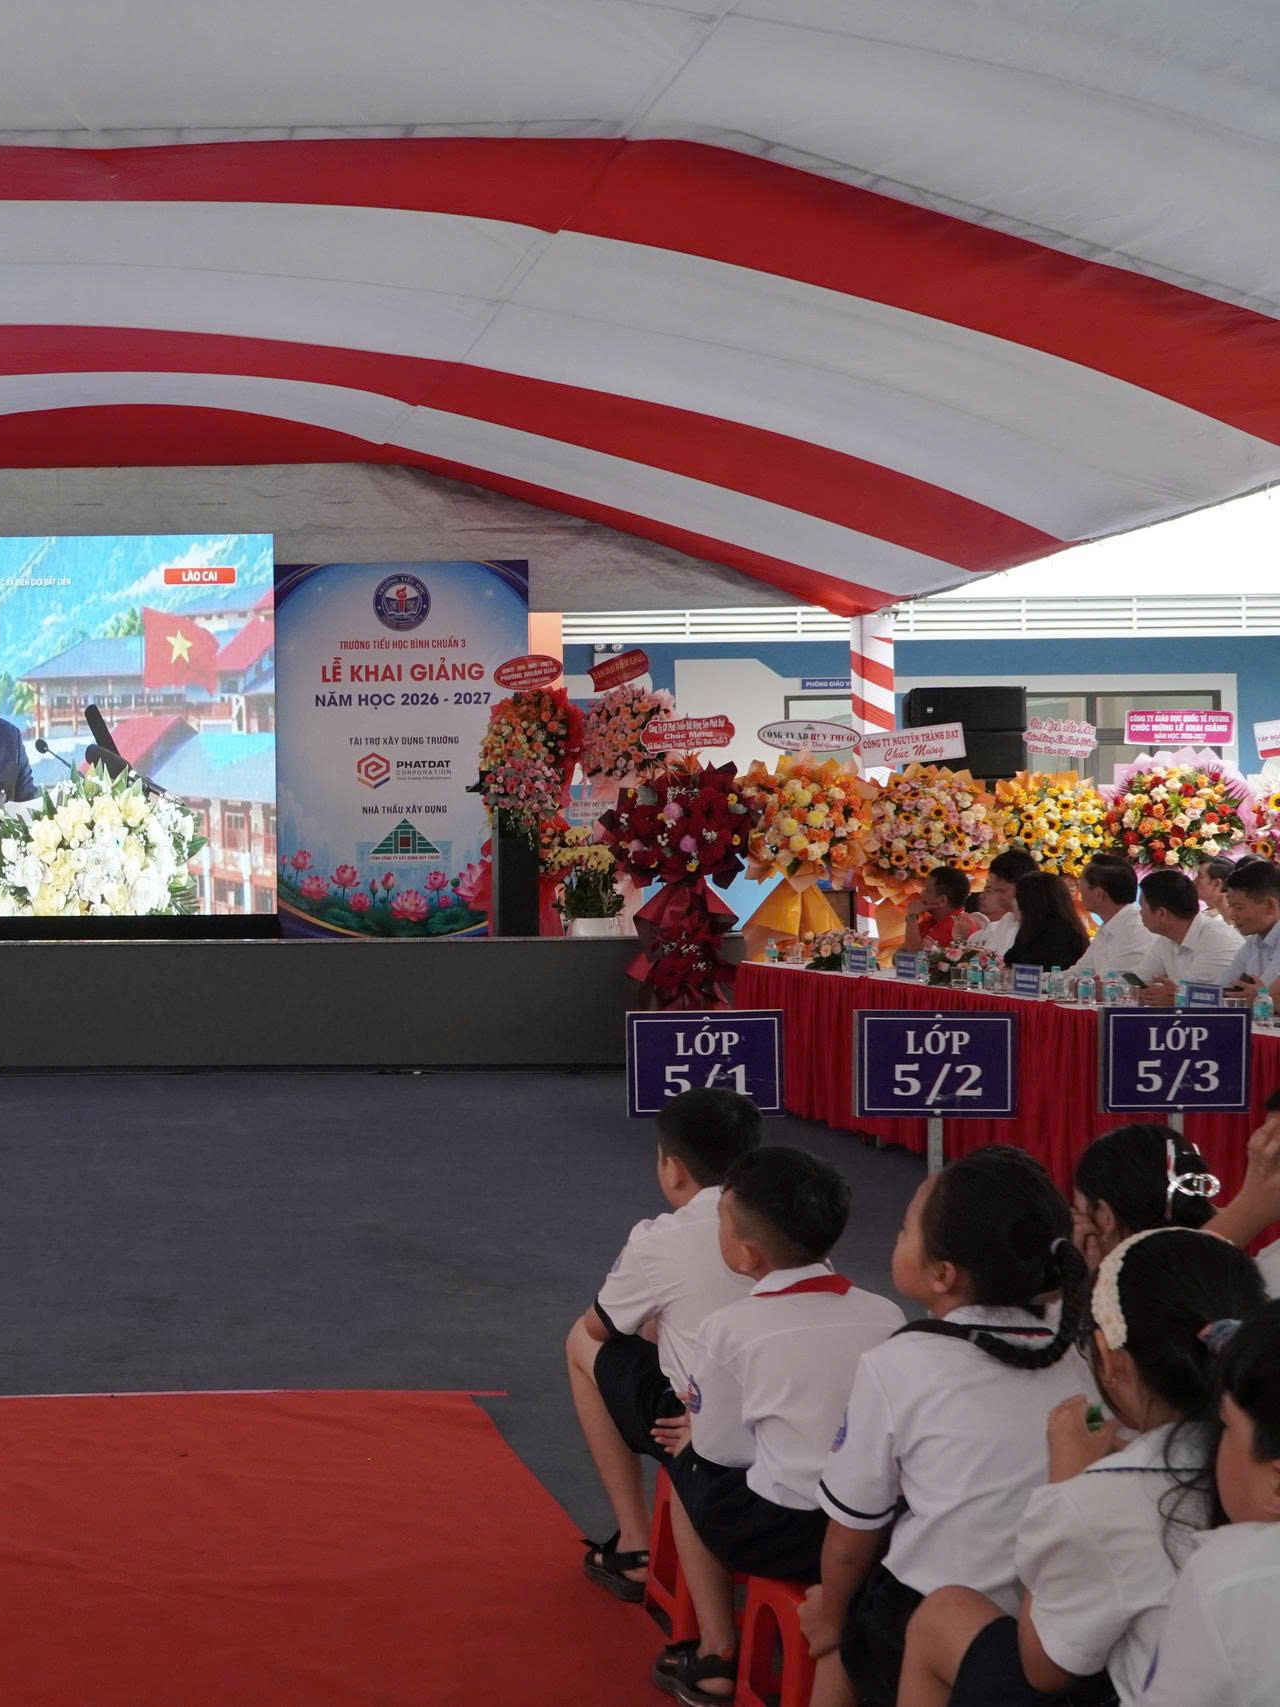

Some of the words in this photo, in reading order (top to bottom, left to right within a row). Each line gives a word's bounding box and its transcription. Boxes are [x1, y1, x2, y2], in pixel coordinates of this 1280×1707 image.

[182, 569, 200, 582] LÀO
[202, 571, 218, 582] CAI
[340, 639, 370, 650] TRƯỜNG
[373, 637, 390, 650] TIỂU
[392, 640, 408, 650] HỌC
[410, 638, 430, 649] BÌNH
[432, 636, 458, 649] CHUẨN
[460, 639, 466, 648] 3
[321, 657, 342, 683] LỄ
[350, 664, 402, 682] KHAI
[410, 657, 484, 682] GIẢNG
[315, 692, 352, 708] NĂM
[358, 694, 396, 710] HỌC
[401, 692, 440, 706] 2026
[454, 692, 491, 705] 2027
[763, 729, 782, 738] CÔNG
[796, 732, 808, 740] XD
[1130, 723, 1150, 731] CHÚC
[1152, 723, 1174, 731] MỪNG
[1204, 723, 1228, 731] GIẢNG
[349, 736, 362, 746] TÀI
[365, 737, 380, 746] TRỢ
[382, 736, 399, 744] XÂY
[402, 736, 424, 746] DỰNG
[426, 736, 460, 744] TRƯỜNG
[664, 732, 686, 740] Chúc
[863, 738, 880, 749] CÔNG
[882, 738, 891, 747] TY
[946, 730, 959, 741] ĐẠT
[884, 748, 909, 761] Chúc
[396, 760, 451, 768] PHATDAT
[362, 805, 379, 814] NHÀ
[382, 804, 404, 814] THẦU
[406, 804, 422, 814] XÂY
[425, 805, 447, 815] DỰNG
[675, 1025, 739, 1055] LỚP
[905, 1024, 970, 1054] LỚP
[1148, 1020, 1208, 1050] LỚP
[664, 1064, 753, 1097] 5/1
[893, 1063, 983, 1105] 5/2
[1136, 1059, 1219, 1101] 5/3
